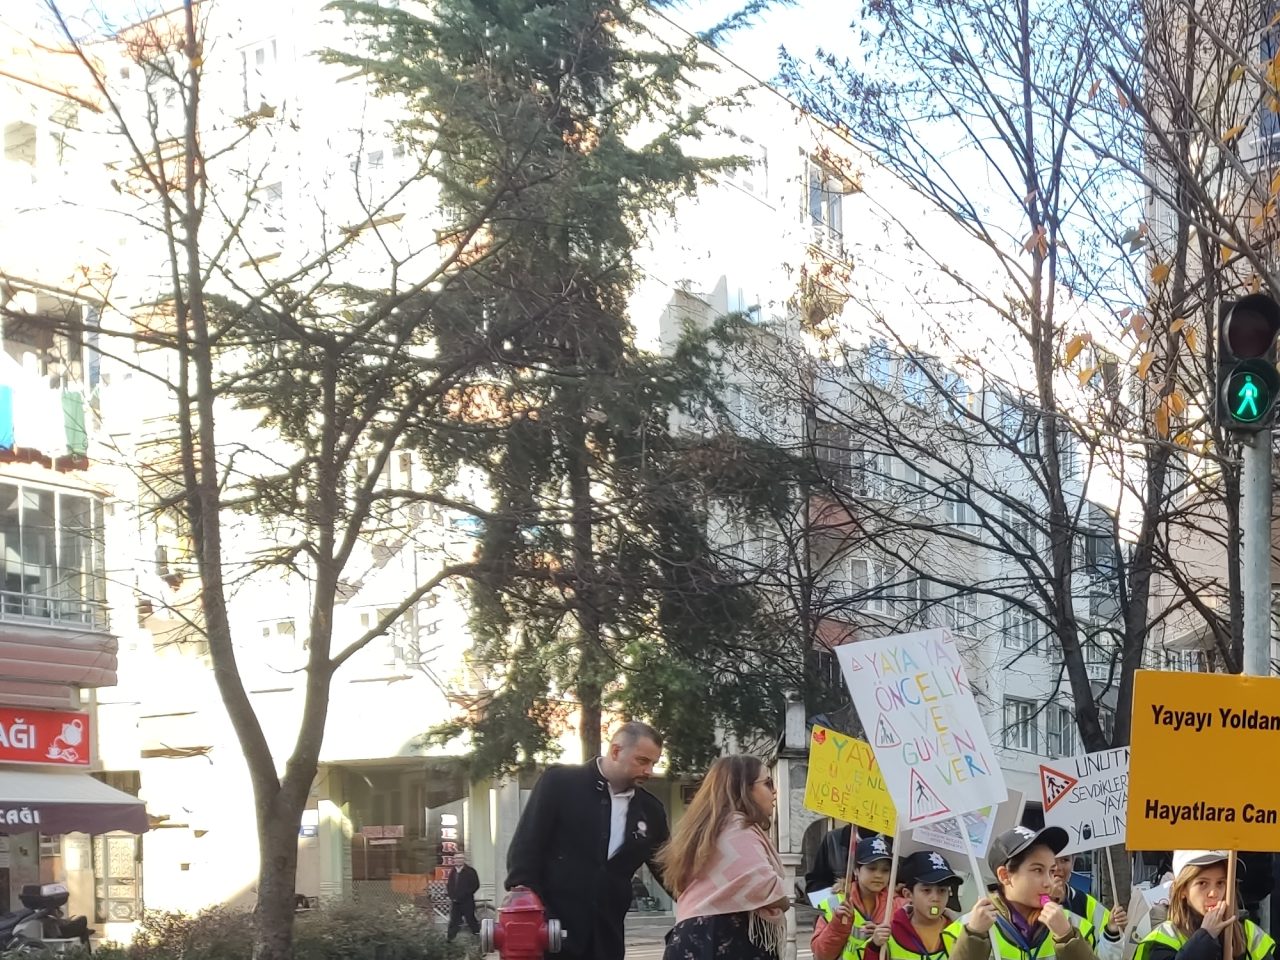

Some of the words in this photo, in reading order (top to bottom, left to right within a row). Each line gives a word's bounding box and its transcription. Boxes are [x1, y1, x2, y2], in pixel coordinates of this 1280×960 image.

[865, 646, 918, 678] YAYA
[1151, 704, 1212, 732] Yayayı
[1219, 707, 1280, 731] Yoldan
[832, 736, 876, 771] YAY
[1068, 774, 1129, 803] SEVDİKLER
[1145, 799, 1236, 825] Hayatlara
[1242, 803, 1277, 824] Can
[1070, 815, 1127, 845] YOLUN
